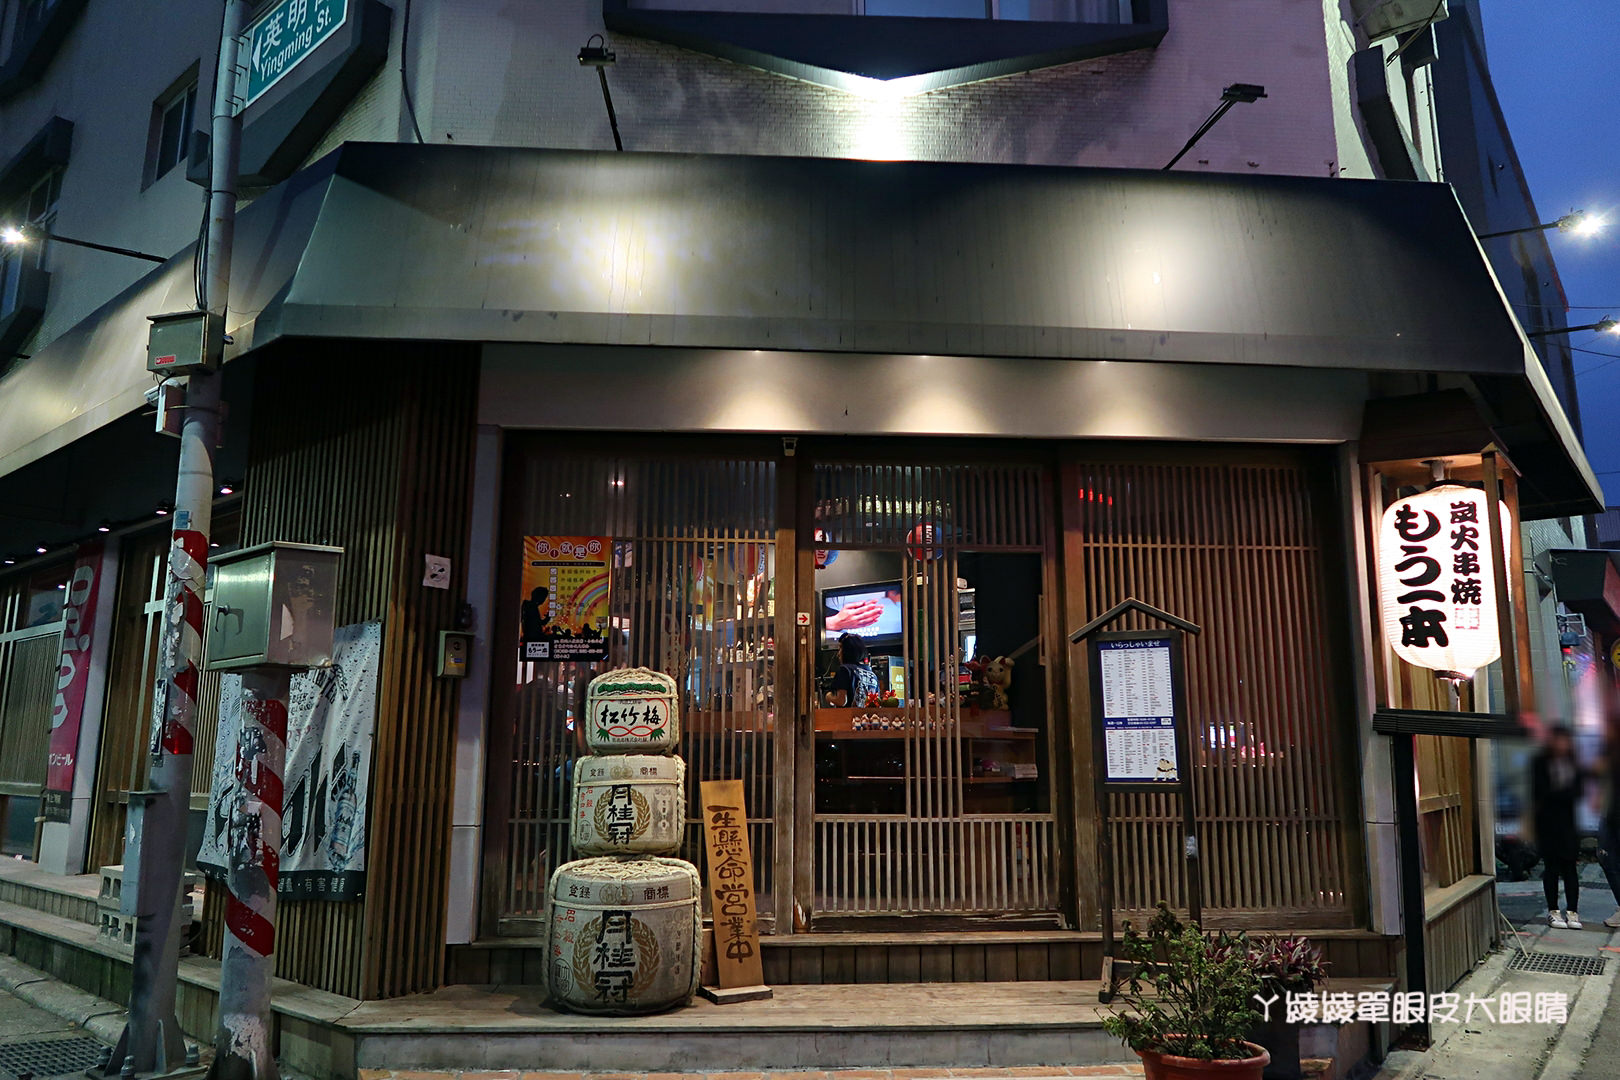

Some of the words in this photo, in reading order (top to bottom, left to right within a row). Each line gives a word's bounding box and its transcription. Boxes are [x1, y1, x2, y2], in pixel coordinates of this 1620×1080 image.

[260, 24, 313, 82] Yingming
[316, 6, 332, 33] St.
[262, 0, 330, 58] 英明
[1394, 503, 1450, 649] もう一本
[1110, 640, 1161, 649] いらっしゃいませ
[600, 703, 662, 727] 松竹梅
[606, 784, 635, 846] 月桂冠
[643, 886, 671, 901] 商標
[592, 909, 637, 1004] 月桂冠
